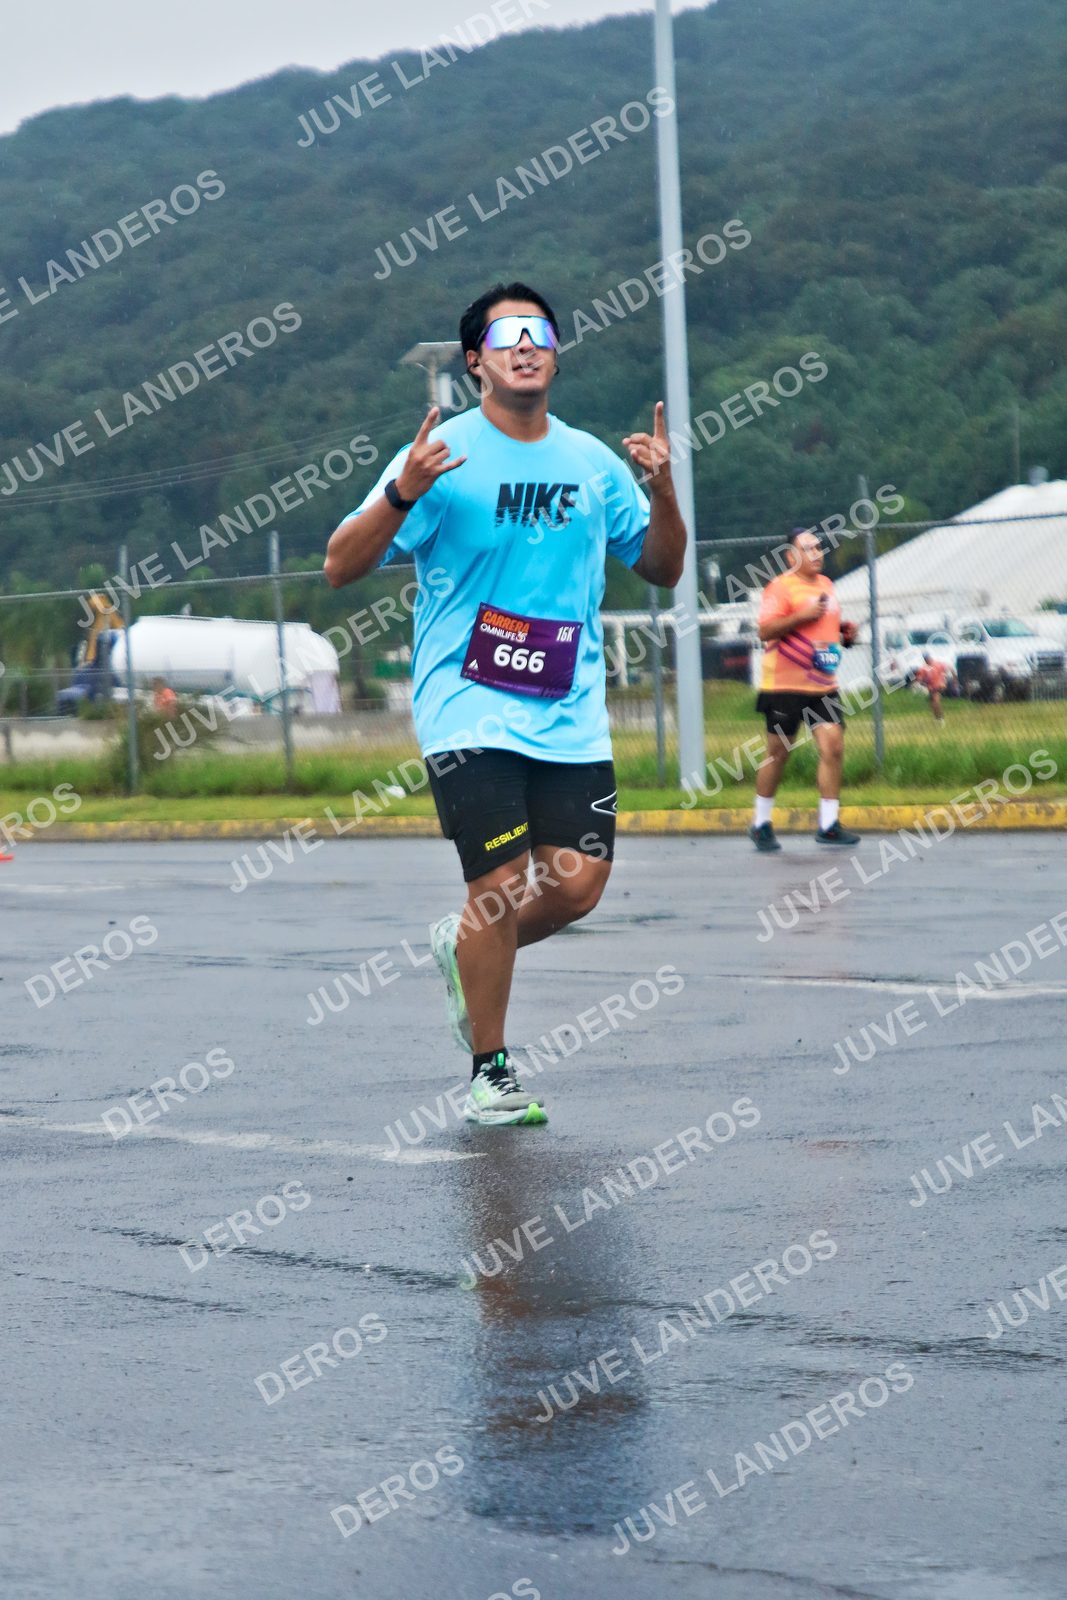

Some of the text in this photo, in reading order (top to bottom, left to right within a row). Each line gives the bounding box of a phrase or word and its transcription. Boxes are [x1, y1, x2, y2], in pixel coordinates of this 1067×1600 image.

[495, 483, 579, 527] NIKE
[480, 622, 516, 641] OMNILIFE
[482, 610, 531, 637] CARRERA
[493, 644, 546, 674] 666
